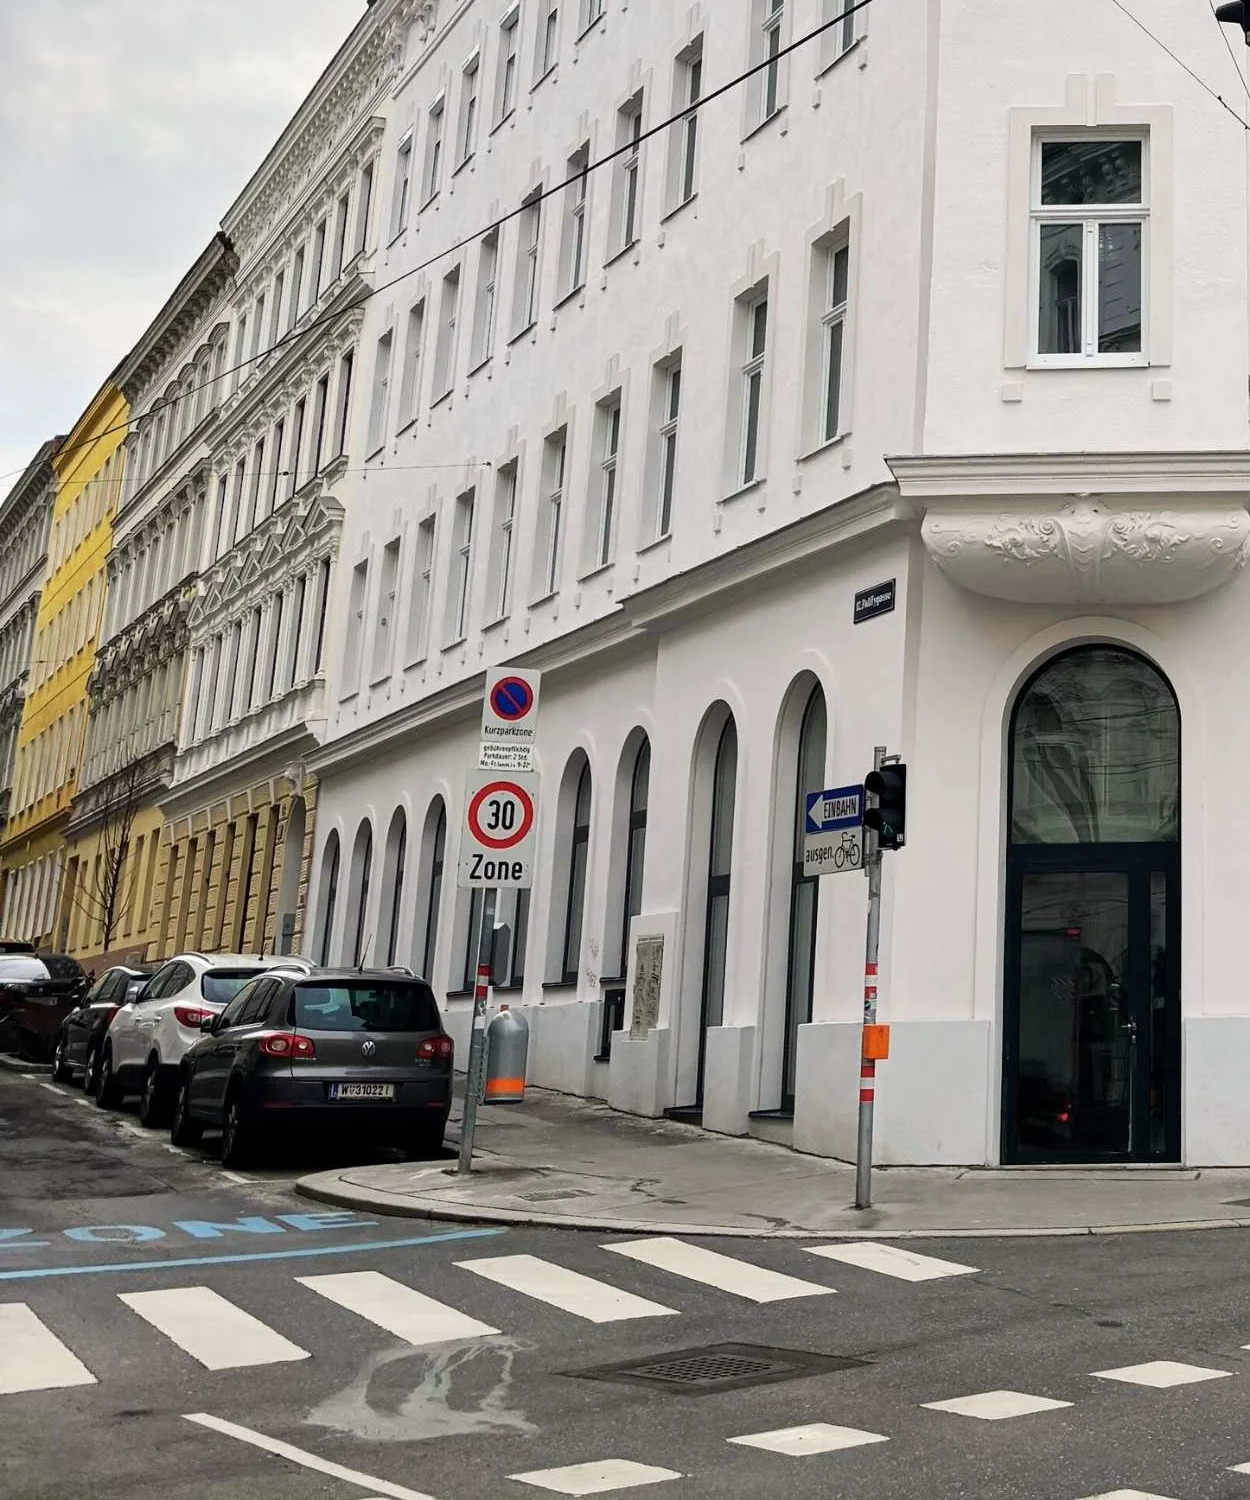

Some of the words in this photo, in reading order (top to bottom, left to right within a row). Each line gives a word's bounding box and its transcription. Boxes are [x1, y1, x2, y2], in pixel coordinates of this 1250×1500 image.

[484, 725, 533, 736] Kurzparkzone
[487, 800, 515, 830] 30
[824, 798, 857, 819] EINBAHN
[806, 846, 835, 864] ausgen.
[469, 853, 523, 880] Zone
